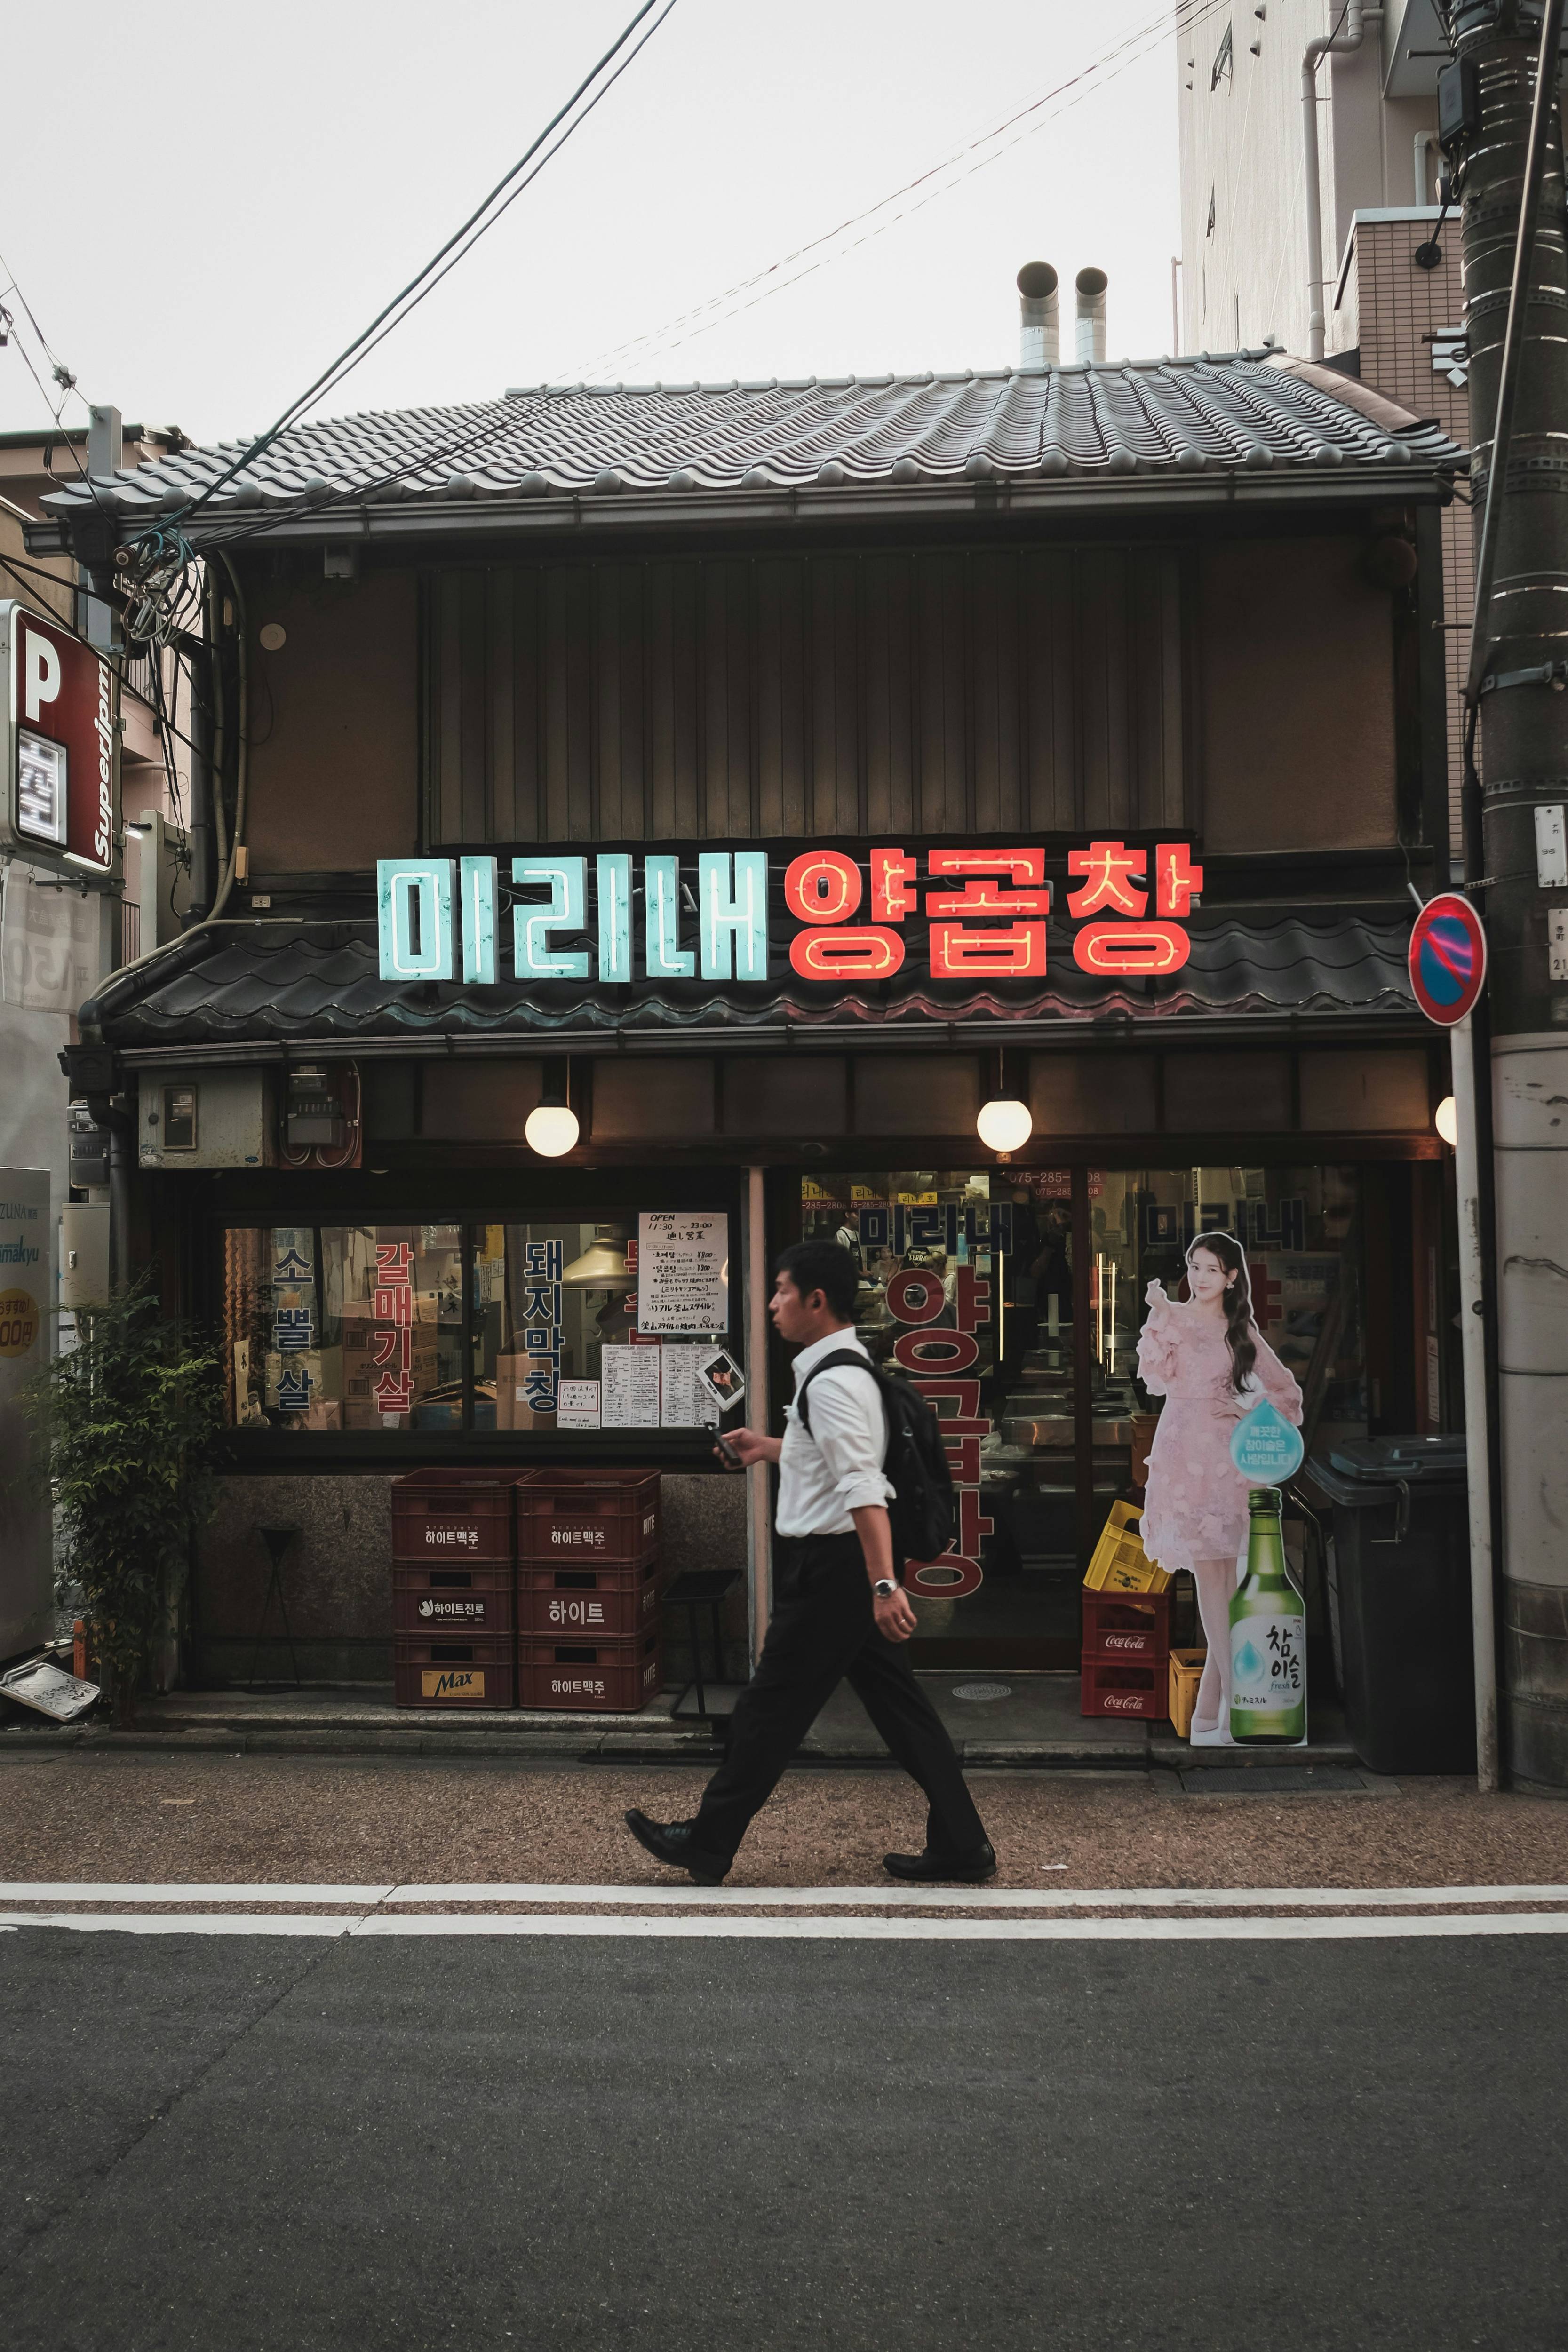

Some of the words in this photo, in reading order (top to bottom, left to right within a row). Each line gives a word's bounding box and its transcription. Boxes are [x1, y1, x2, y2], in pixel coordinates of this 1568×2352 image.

[25, 628, 61, 723] P
[94, 660, 113, 865] Superjpm
[376, 851, 769, 985] 미리내
[784, 841, 1205, 981] 양곱창
[858, 1202, 1014, 1258] 미리내
[373, 1242, 414, 1413] 갈매기살
[523, 1239, 565, 1413] 돼지막창
[1245, 1439, 1286, 1452] 참이슬은
[643, 1514, 655, 1536] HITE
[425, 1531, 478, 1545] 하이트맥주
[551, 1531, 605, 1545] 하이트맥주
[434, 1603, 485, 1615] 하이트진로
[549, 1601, 605, 1625] 하이트
[1266, 1624, 1293, 1657] 참
[644, 1663, 656, 1687] HITE
[1271, 1654, 1301, 1689] 이슬
[434, 1672, 473, 1697] Max
[551, 1680, 605, 1694] 하이트맥주
[1268, 1680, 1290, 1692] fresh
